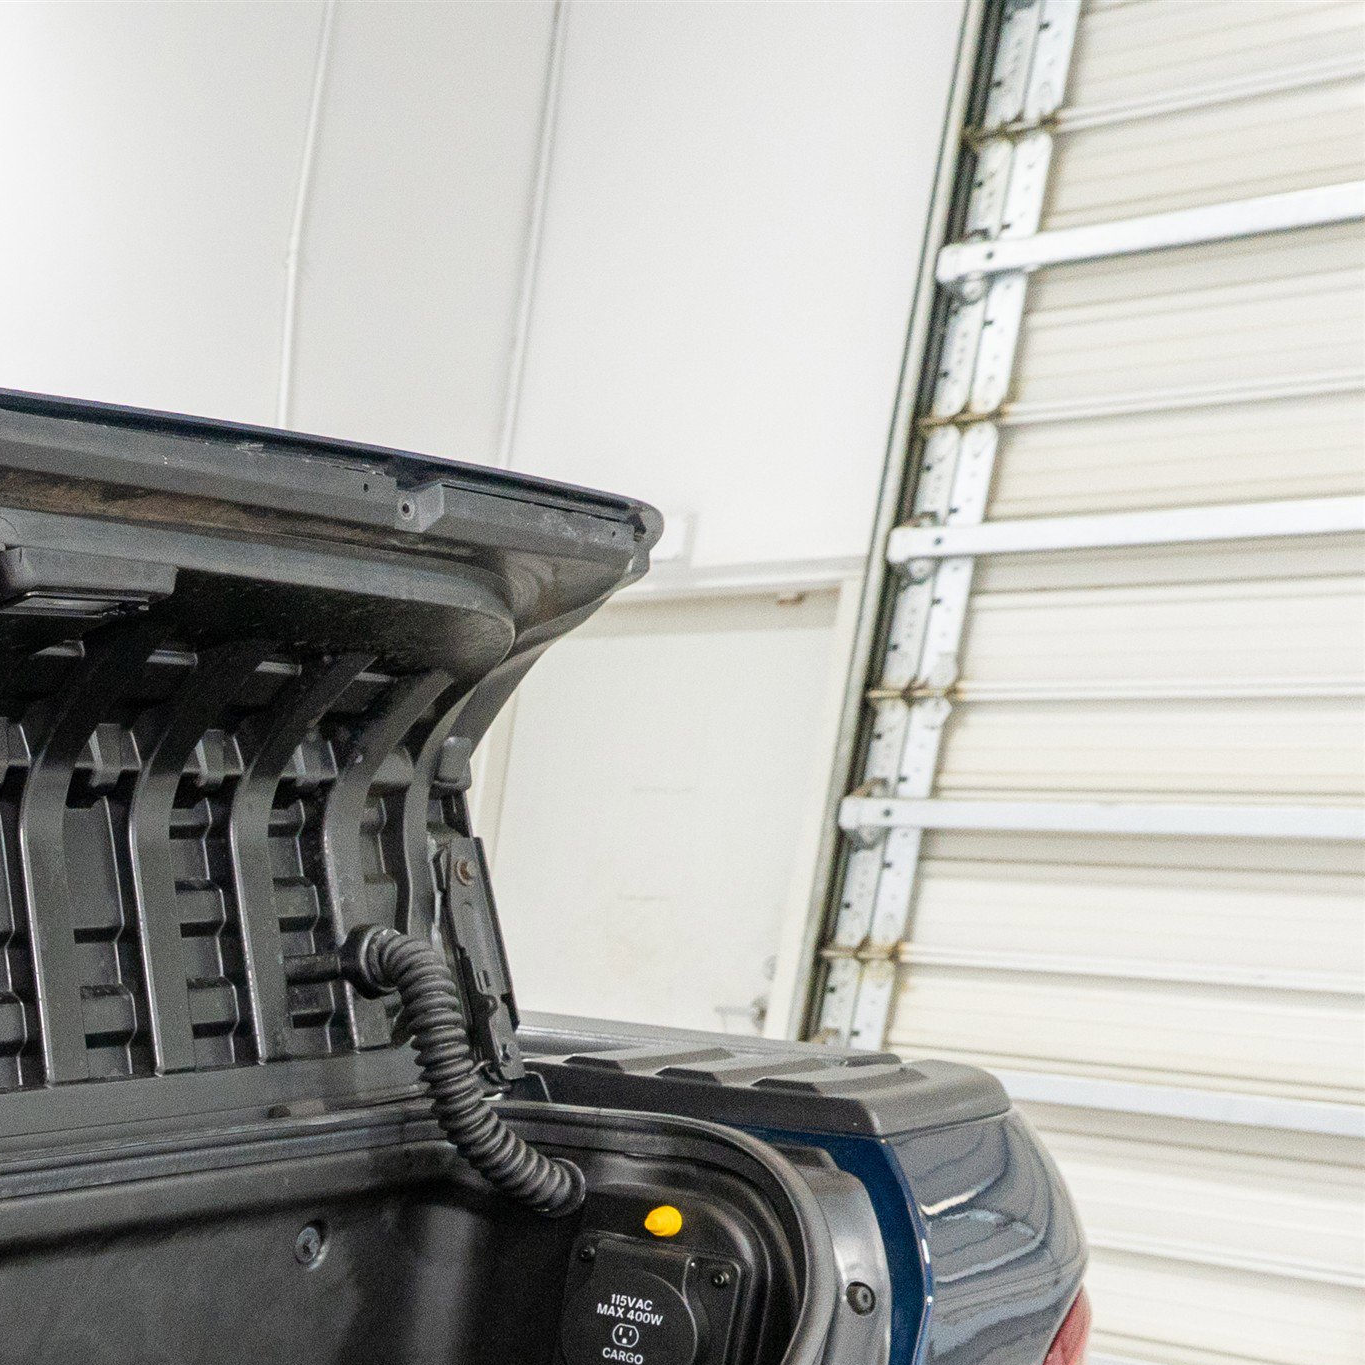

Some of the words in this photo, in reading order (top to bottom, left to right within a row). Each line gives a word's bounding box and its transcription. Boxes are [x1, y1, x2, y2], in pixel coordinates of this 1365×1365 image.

[611, 1293, 653, 1311] 115VAC
[596, 1302, 625, 1319] MAX
[627, 1309, 664, 1326] 400W
[602, 1347, 644, 1365] CARGO
